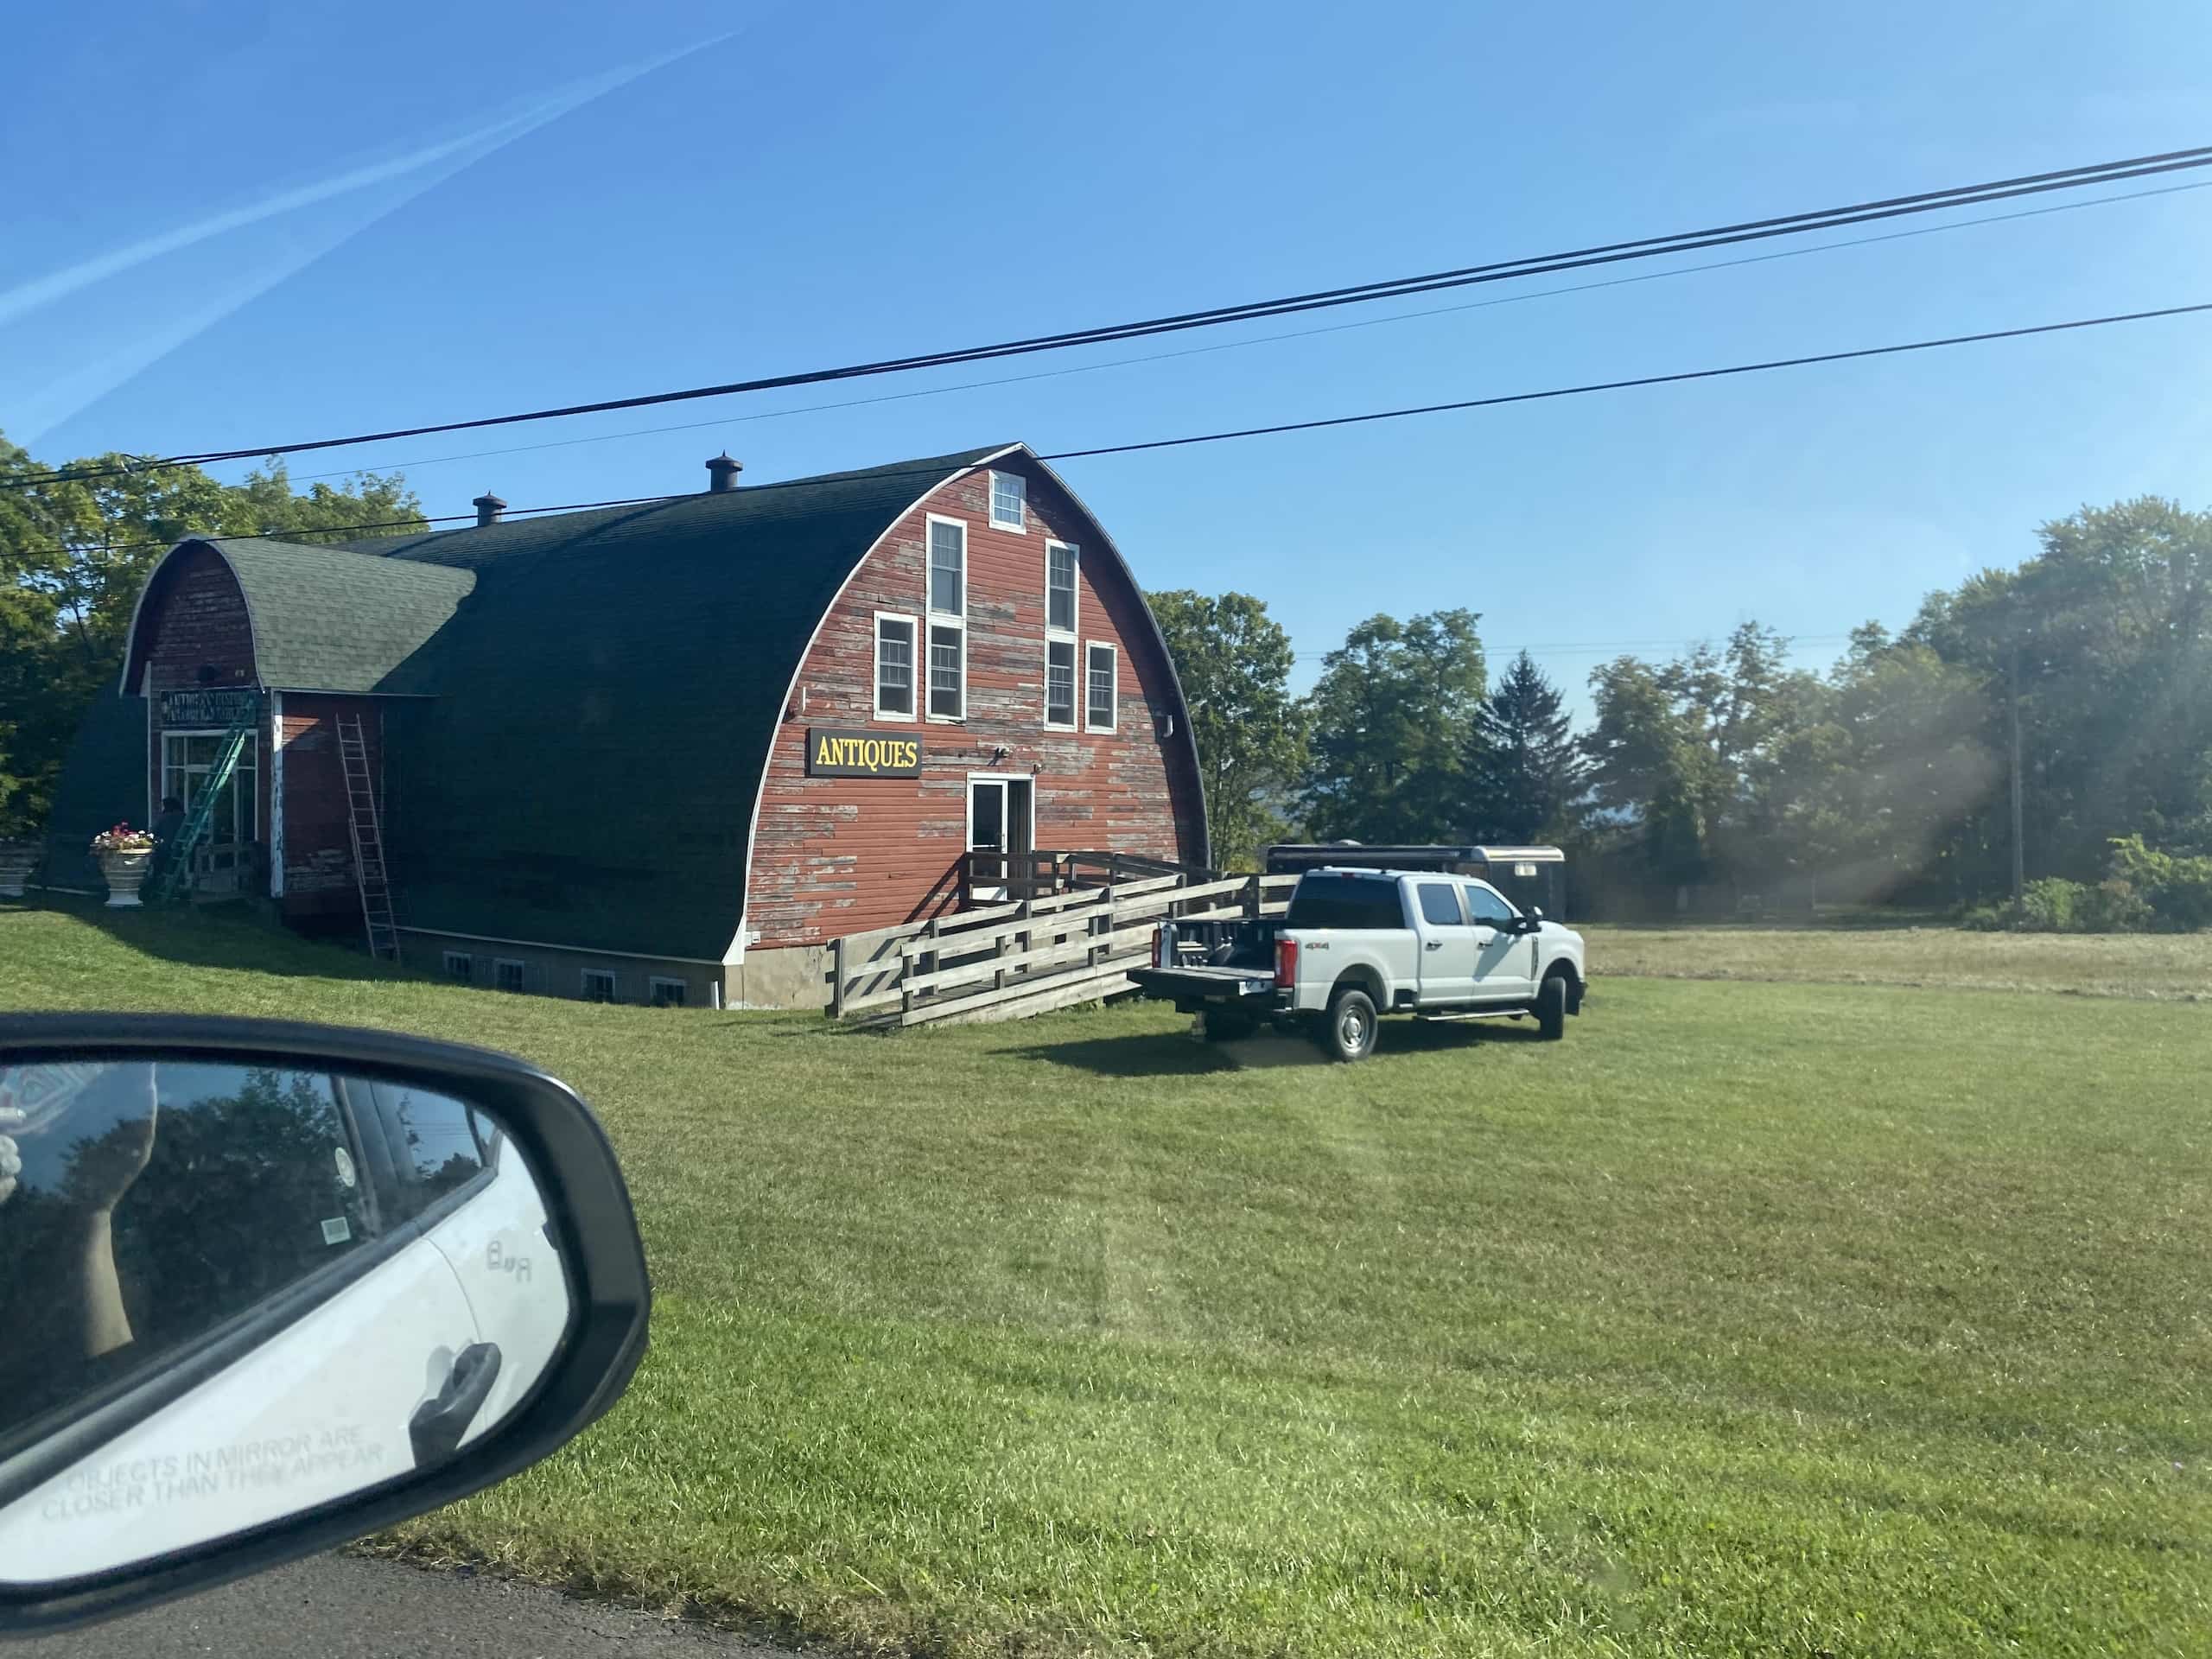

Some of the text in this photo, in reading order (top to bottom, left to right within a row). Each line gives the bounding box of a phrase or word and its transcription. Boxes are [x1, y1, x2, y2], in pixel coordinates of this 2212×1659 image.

[816, 736, 918, 772] ANTIQUES
[43, 1484, 144, 1520] CLOSER
[153, 1471, 219, 1503] THAN
[290, 1443, 385, 1476] APPEAR
[67, 1425, 361, 1491] OBJECTS IN MIRROR ARE
